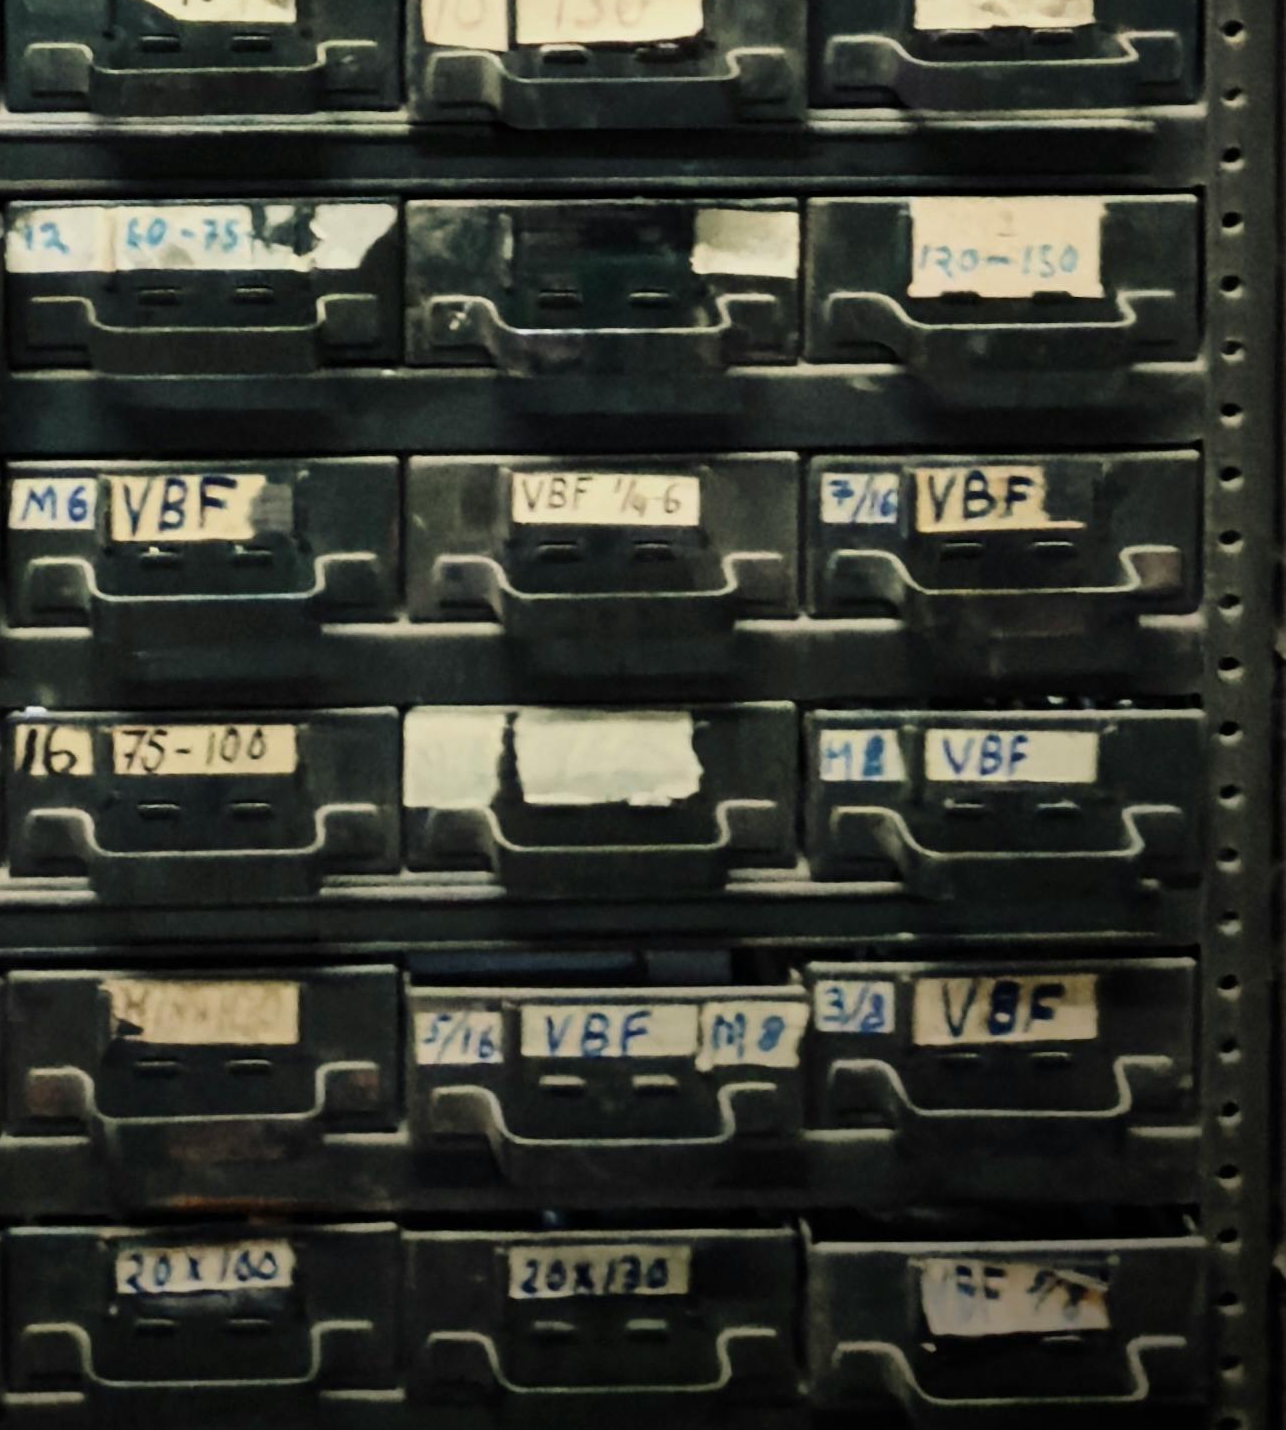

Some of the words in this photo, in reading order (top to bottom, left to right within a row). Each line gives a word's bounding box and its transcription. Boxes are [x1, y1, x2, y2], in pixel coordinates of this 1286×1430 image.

[121, 475, 236, 534] VBF
[522, 477, 593, 510] VBF
[926, 474, 1038, 523] VBF
[23, 726, 78, 777] 16
[942, 735, 1028, 776] VBF
[544, 1010, 651, 1057] VBF
[945, 983, 1065, 1038] VBF
